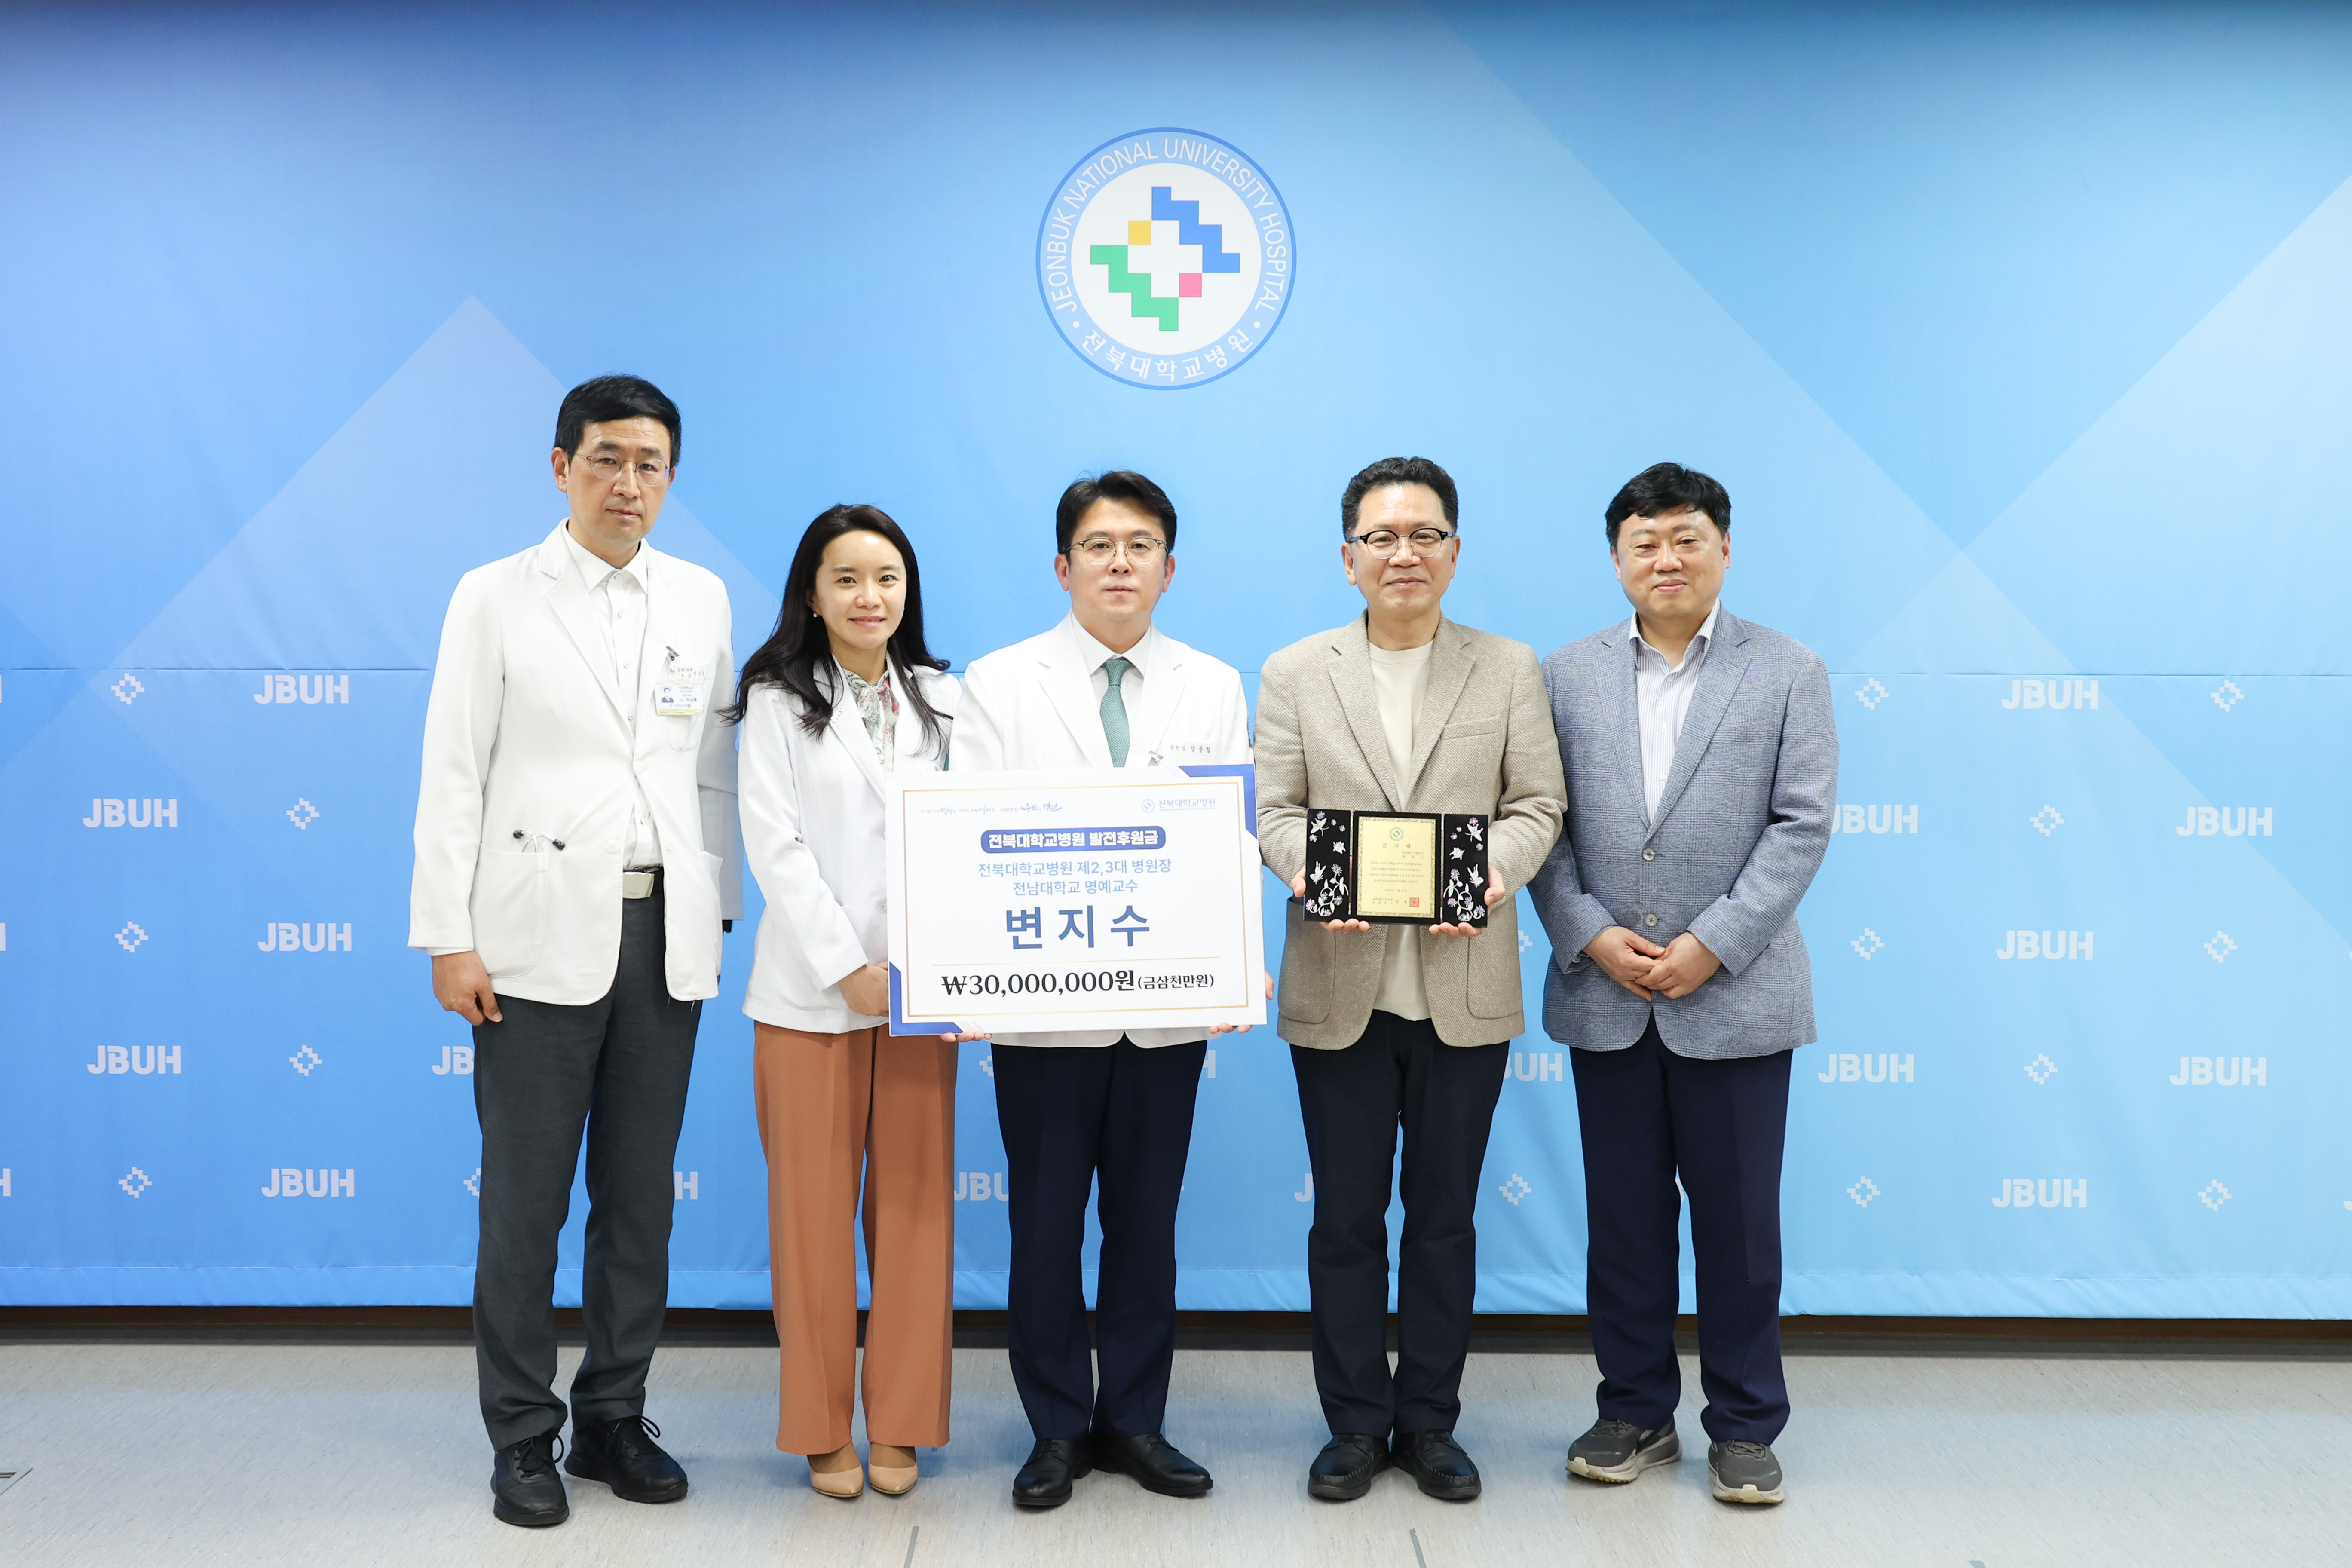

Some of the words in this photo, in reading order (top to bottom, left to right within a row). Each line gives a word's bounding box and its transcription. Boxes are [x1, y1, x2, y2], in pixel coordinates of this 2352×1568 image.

[1046, 208, 1076, 312] JEONBUK
[1063, 140, 1158, 209] NATIONAL
[1164, 138, 1274, 209] UNIVERSITY
[1254, 212, 1287, 311] HOSPITAL
[1081, 328, 1253, 382] 전북대학교병원
[254, 675, 349, 704] JBUH
[2001, 680, 2099, 710] JBUH
[83, 799, 178, 828] JBUH
[1158, 798, 1216, 808] 전북대학교병원
[1830, 805, 1918, 834] JBUH
[2176, 807, 2273, 836] JBUH
[989, 832, 1086, 849] 전북대학교병원
[1089, 830, 1158, 846] 발전후원금
[978, 861, 1072, 877] 전북대학교병원
[1077, 860, 1127, 876] 제2,3대
[1132, 858, 1172, 873] 병원장
[1013, 880, 1081, 896] 전남대학교
[1085, 879, 1139, 894] 명예교수
[258, 923, 352, 952] JBUH
[1997, 930, 2094, 961] JBUH
[87, 1046, 182, 1075] JBUH
[432, 1046, 474, 1075] JB
[1504, 1052, 1563, 1081] UH
[1818, 1054, 1914, 1083] JBUH
[2170, 1057, 2267, 1087] JBUH
[261, 1169, 355, 1198] JBUH
[954, 1172, 1009, 1201] JBU
[1992, 1179, 2087, 1208] JBUH
